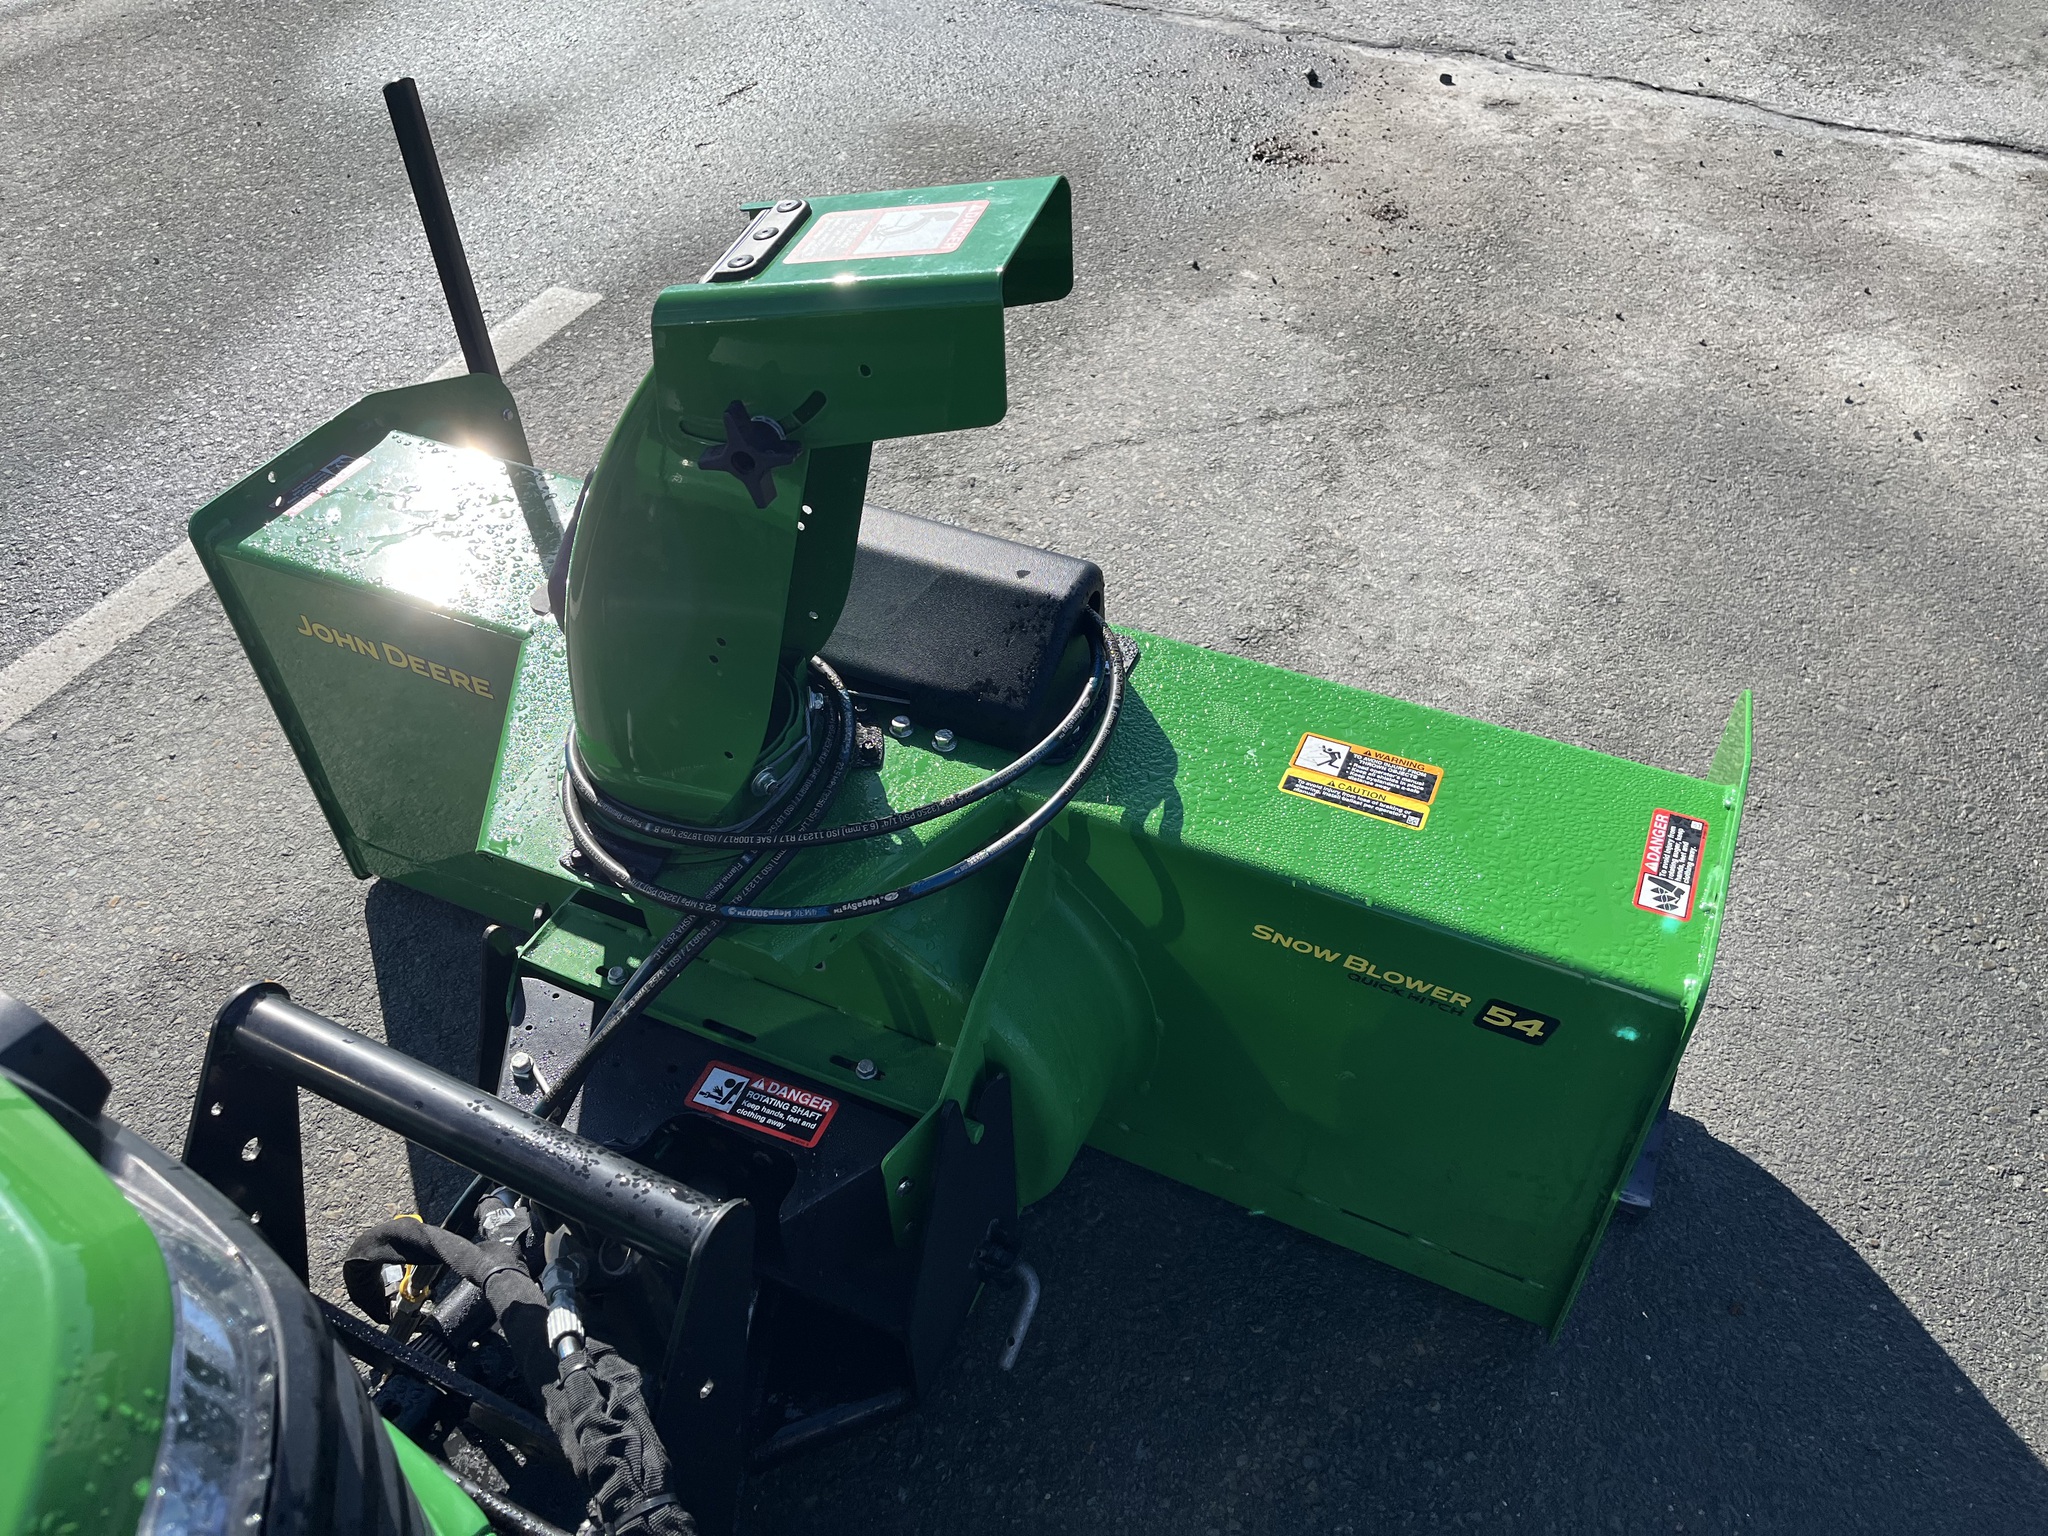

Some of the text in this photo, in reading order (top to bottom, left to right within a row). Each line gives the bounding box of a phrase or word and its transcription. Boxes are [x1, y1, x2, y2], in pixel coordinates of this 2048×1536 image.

[297, 613, 495, 700] JOHN DEERE
[1359, 760, 1418, 780] THROWN OBJECTS
[1363, 757, 1383, 766] AVOID
[1383, 762, 1408, 772] INJURY
[1407, 768, 1427, 778] FROM
[1374, 752, 1426, 771] WARNING
[1297, 778, 1305, 786] To
[1305, 781, 1323, 791] avoid
[1323, 785, 1340, 796] injury
[1341, 791, 1357, 800] from
[1357, 795, 1371, 804] loss
[1379, 801, 1403, 815] braking
[1337, 782, 1387, 801] CAUTION
[1363, 802, 1375, 811] per
[621, 814, 644, 829] Flame
[659, 827, 679, 838] Type
[678, 830, 703, 842] 18752
[703, 834, 717, 842] ISO
[723, 835, 754, 844] 100R17
[756, 836, 772, 844] SAE
[779, 833, 796, 843] R17
[798, 831, 825, 843] 11237
[1646, 813, 1669, 862] DANGER
[761, 863, 775, 876] ISO
[1661, 853, 1671, 870] avoid
[722, 861, 744, 883] Flame
[1658, 868, 1668, 878] To
[1683, 861, 1695, 885] clothing
[705, 881, 725, 901] Resis
[743, 875, 764, 897] 11237
[681, 897, 699, 909] MPa
[833, 896, 881, 916] MegaSys™
[653, 914, 698, 961] MSHA 2G-11C
[683, 925, 712, 953] 100R17
[668, 954, 683, 969] ISO
[1251, 924, 1473, 1008] SNOW BLOWER
[650, 966, 671, 989] 18752
[1347, 972, 1465, 1017] QUICK HITCH
[1482, 1005, 1544, 1037] 54
[746, 1090, 822, 1121] ROTATING SHAFT
[767, 1081, 833, 1112] DANGER
[736, 1108, 786, 1130] clothing away
[741, 1099, 817, 1130] Keep hands, feet and
